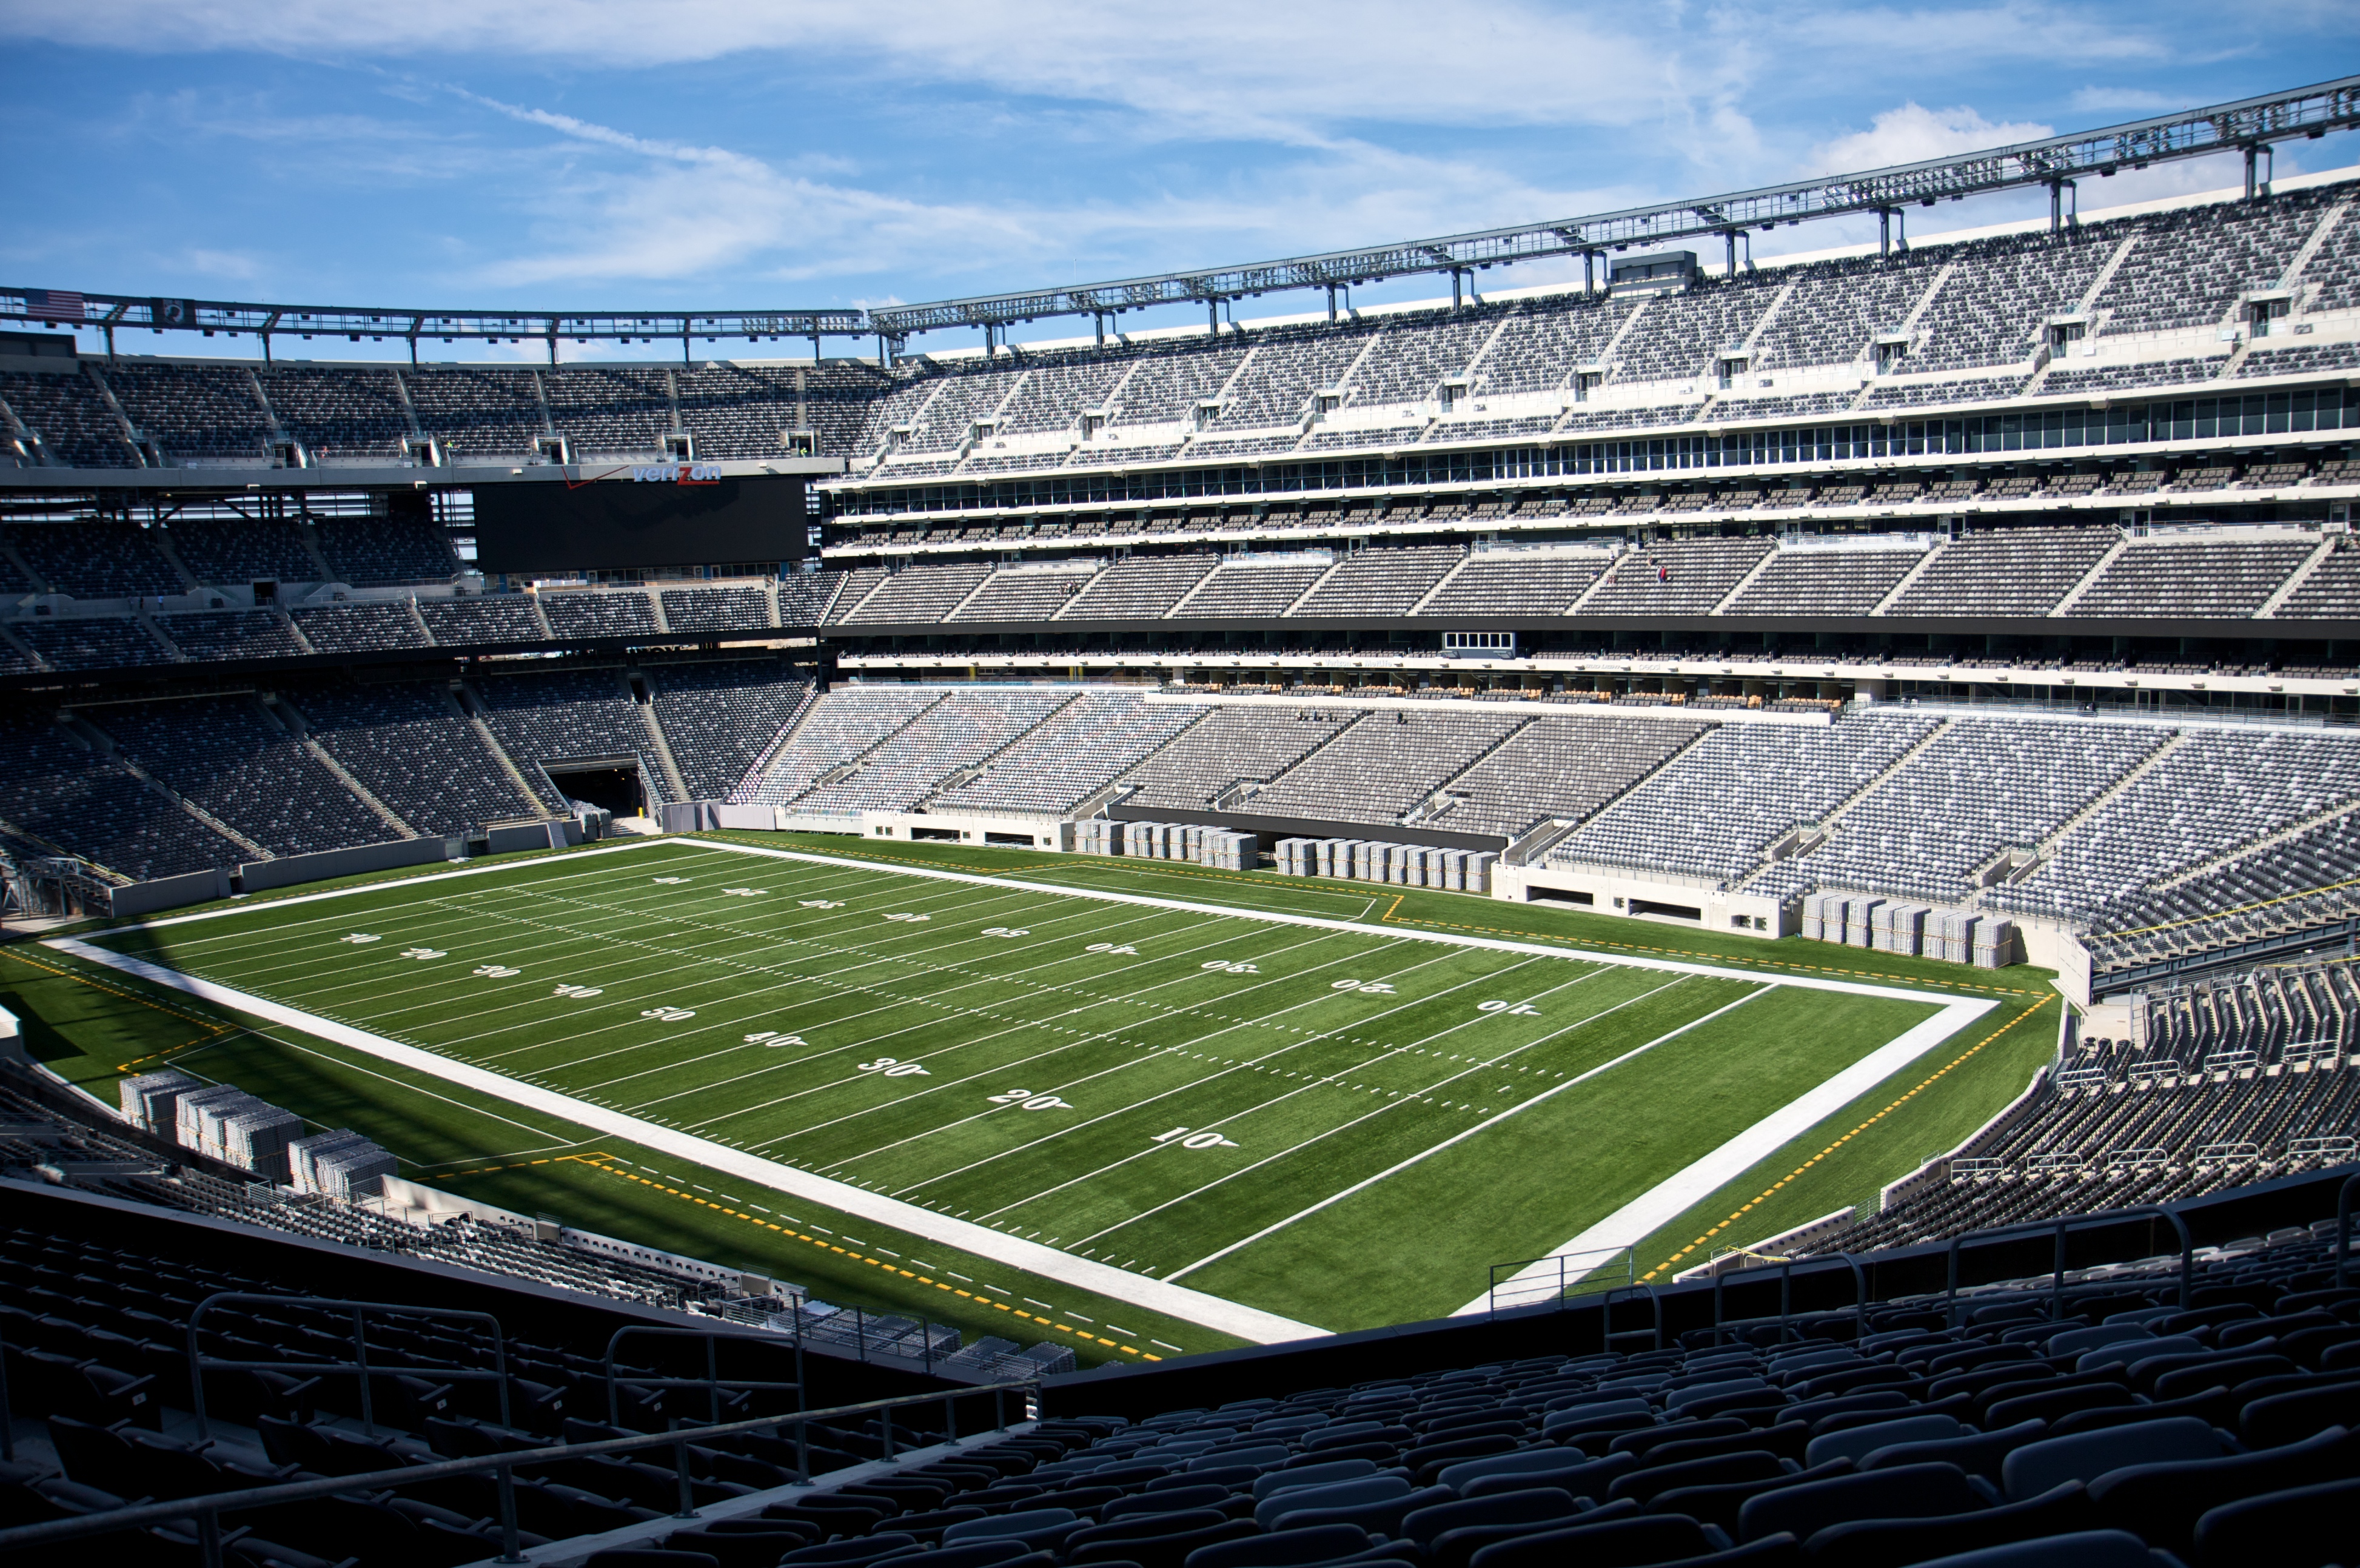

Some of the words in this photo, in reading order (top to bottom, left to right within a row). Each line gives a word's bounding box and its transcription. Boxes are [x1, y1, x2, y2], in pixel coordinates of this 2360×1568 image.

[632, 462, 722, 485] verizon
[725, 888, 769, 896] 20
[801, 900, 845, 909] 30
[887, 913, 931, 922] 40
[340, 934, 382, 943] 10
[981, 927, 1030, 938] 50
[400, 948, 448, 959] 20
[1085, 943, 1136, 954] 40
[473, 965, 521, 977] 30
[1201, 960, 1257, 973] 30
[553, 985, 603, 998] 40
[1330, 979, 1393, 993] 20
[641, 1006, 696, 1020] 50
[1477, 1000, 1536, 1014] 10
[743, 1031, 801, 1047] 40
[858, 1057, 922, 1076] 30
[987, 1089, 1061, 1110] 20
[1150, 1127, 1224, 1148] 10
